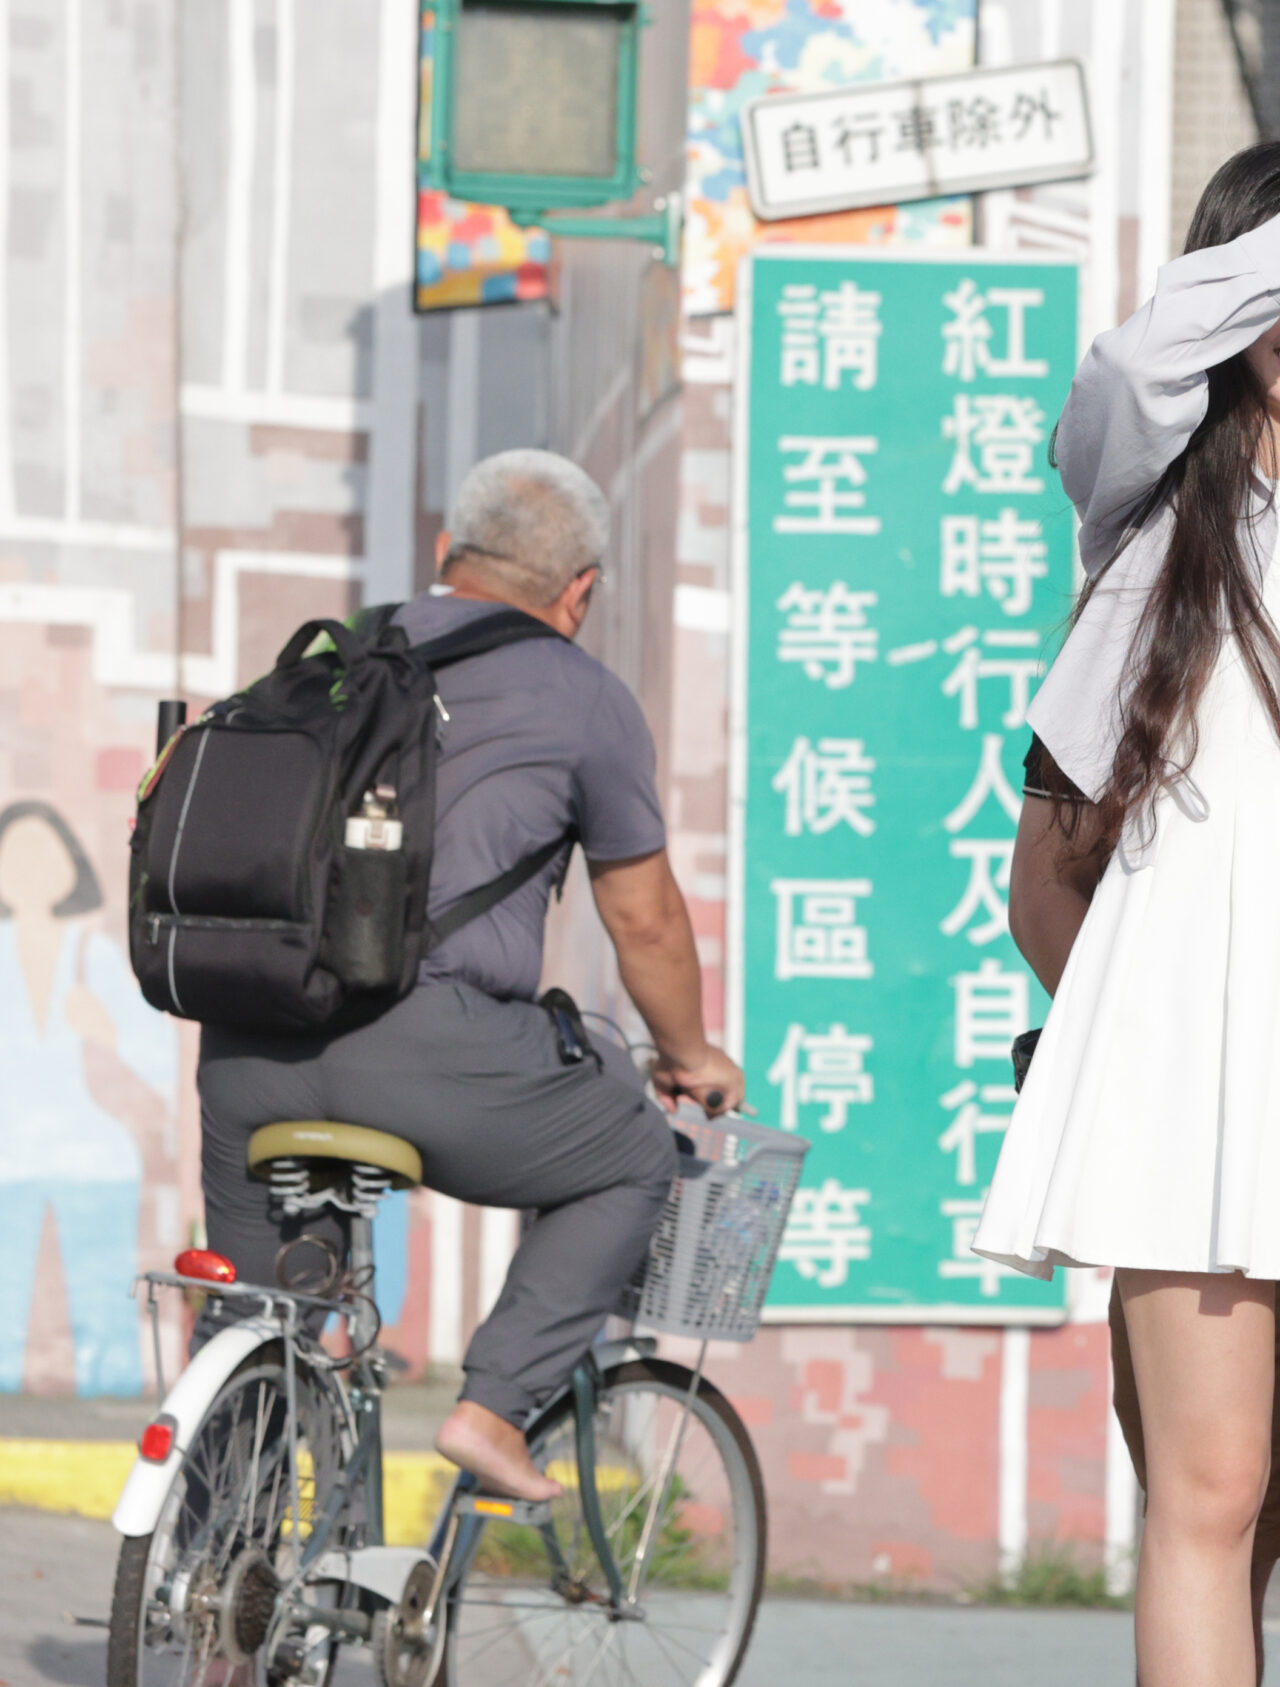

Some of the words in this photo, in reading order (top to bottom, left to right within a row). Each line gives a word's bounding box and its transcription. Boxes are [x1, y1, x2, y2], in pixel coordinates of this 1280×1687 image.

[780, 87, 1061, 173] 自行車除外
[767, 279, 882, 1288] 請至等候區停等
